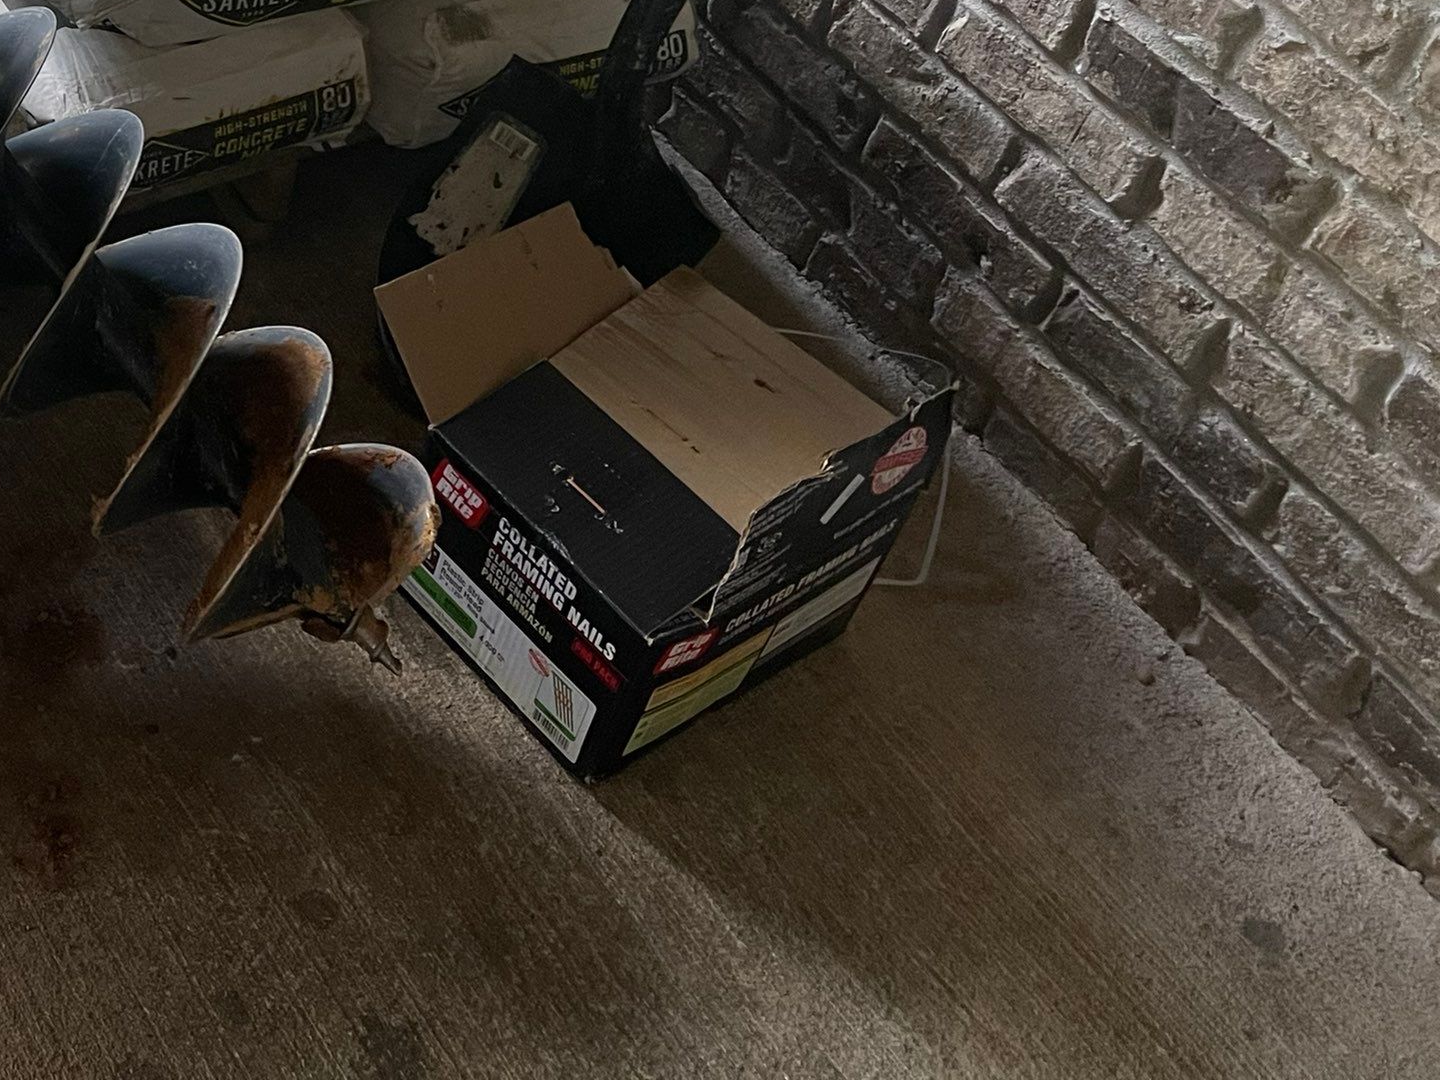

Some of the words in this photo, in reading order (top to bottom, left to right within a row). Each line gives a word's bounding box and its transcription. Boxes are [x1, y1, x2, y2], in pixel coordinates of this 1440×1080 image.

[560, 57, 603, 75] HIGH-ST
[214, 101, 308, 139] HIGH-STRENGTH
[322, 83, 351, 112] 80
[214, 118, 308, 158] CONCRETE
[135, 150, 193, 182] KRETE
[435, 477, 474, 520] Rite
[442, 463, 484, 509] Grip
[487, 547, 524, 591] CLAVOS
[523, 586, 540, 604] EN
[498, 516, 578, 602] COLLATED
[480, 567, 505, 598] PARA
[506, 592, 554, 645] ARMAZÓN
[484, 557, 537, 614] SECUENCIA
[491, 530, 565, 612] FRAMING
[566, 607, 617, 662] NAILS
[725, 583, 796, 633] COLLATED
